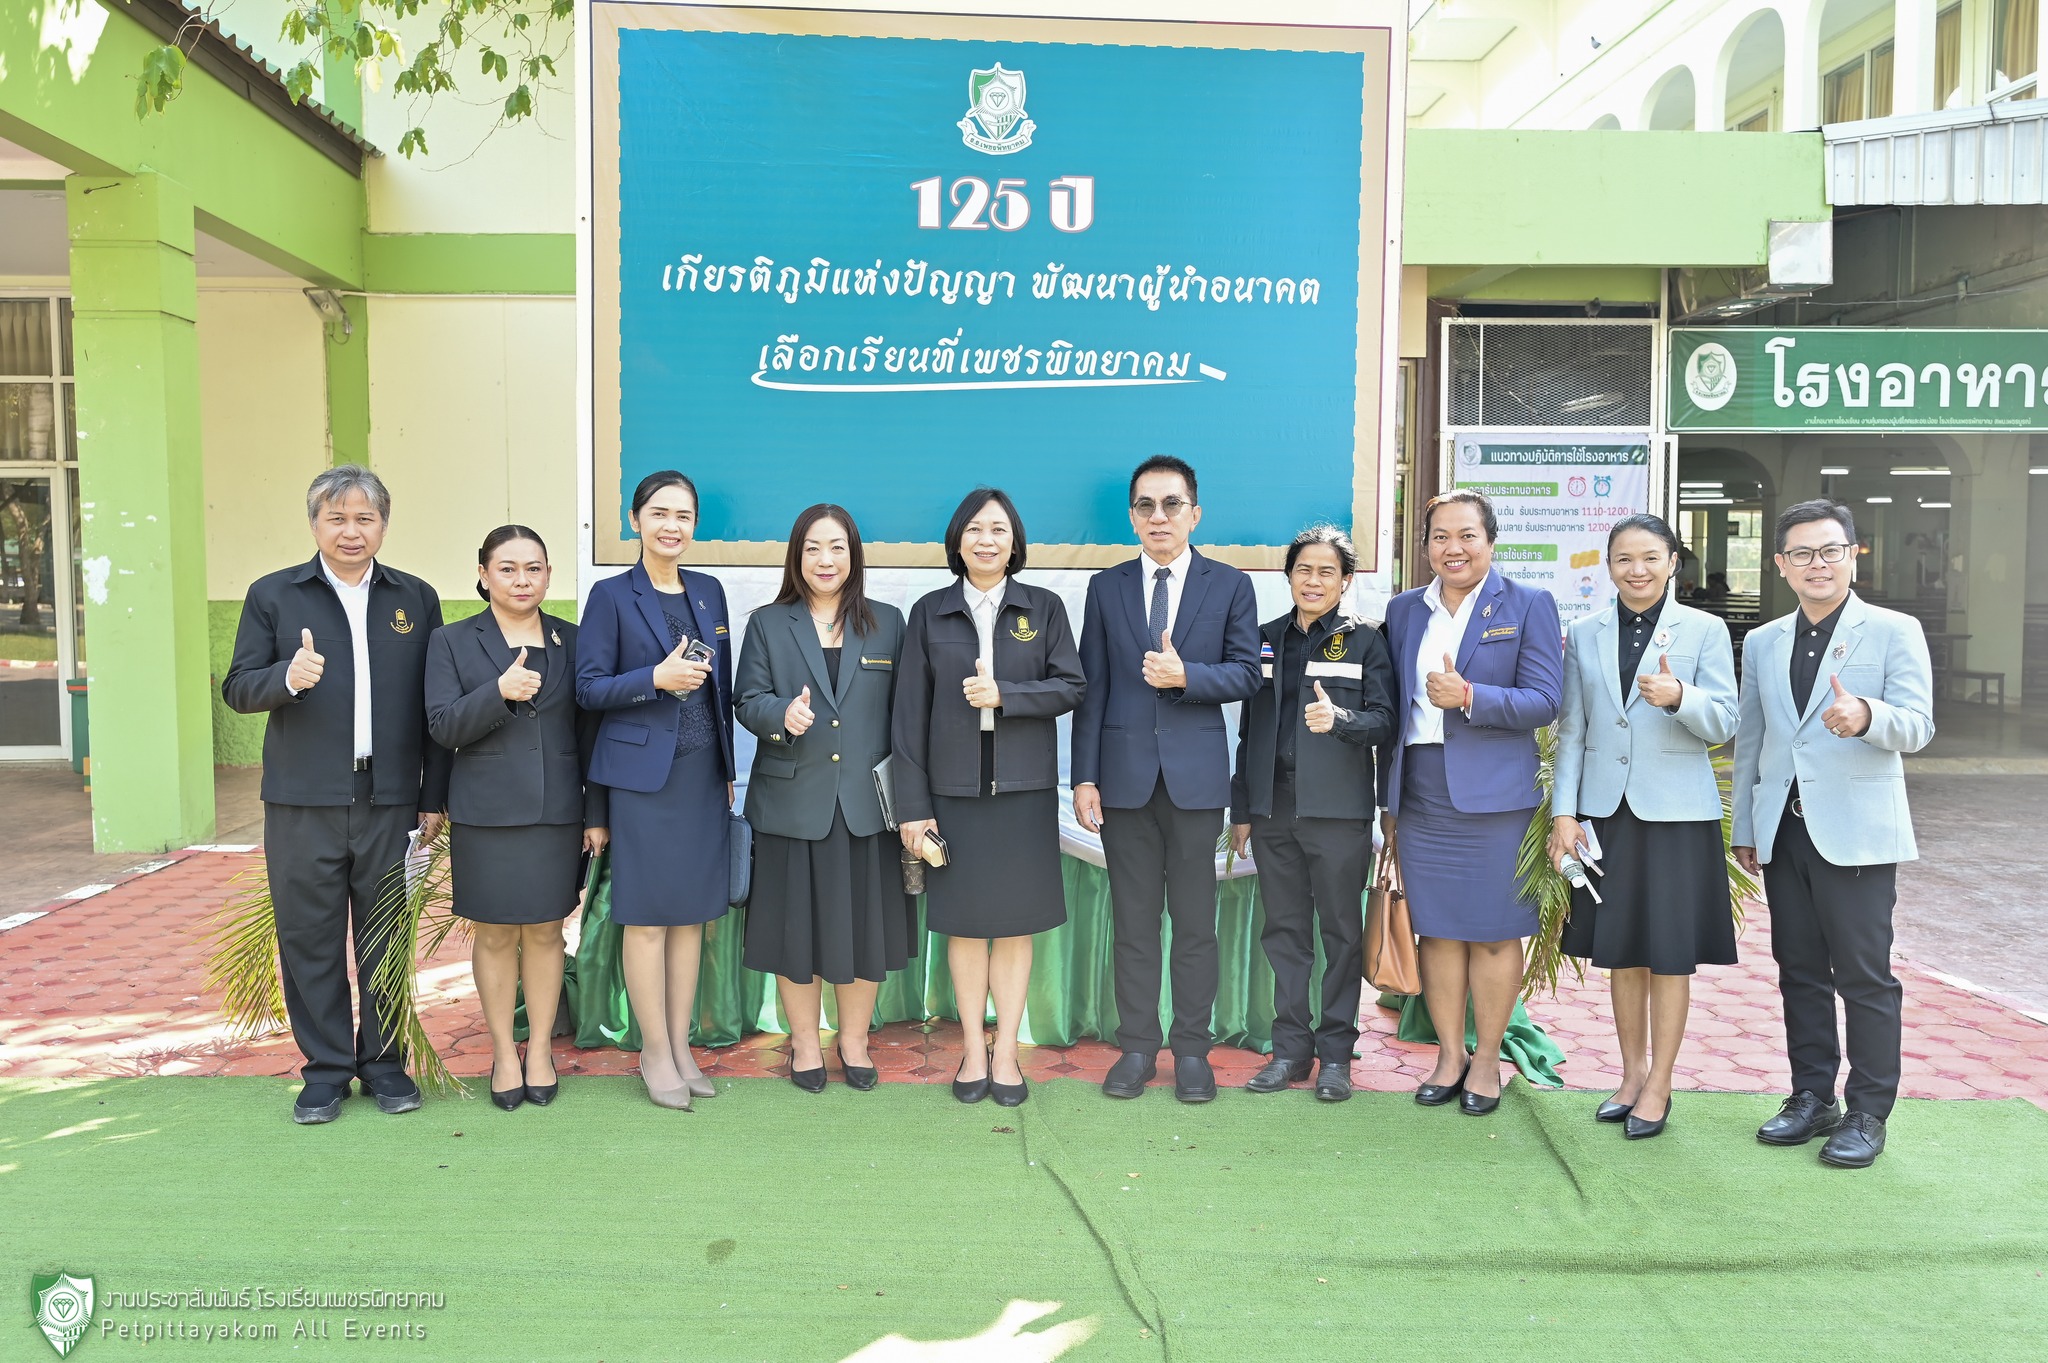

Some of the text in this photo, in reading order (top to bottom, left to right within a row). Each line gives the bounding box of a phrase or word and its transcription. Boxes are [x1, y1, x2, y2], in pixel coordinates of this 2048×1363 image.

[909, 175, 1031, 231] 125
[662, 253, 1321, 311] เกียรติภูมิแห่งปัญญา พัฒนาผู้นำอนาคต
[758, 327, 1192, 378] เลือกเรียนที่เพชรพิทยาคม
[1764, 336, 2047, 408] โรงอาหา
[1490, 446, 1629, 464] แนวทางปฏิบัติการใช้โรงอาหาร
[1519, 505, 1579, 516] รับประทานอาหาร
[1525, 521, 1585, 532] รับประทานอาหาร
